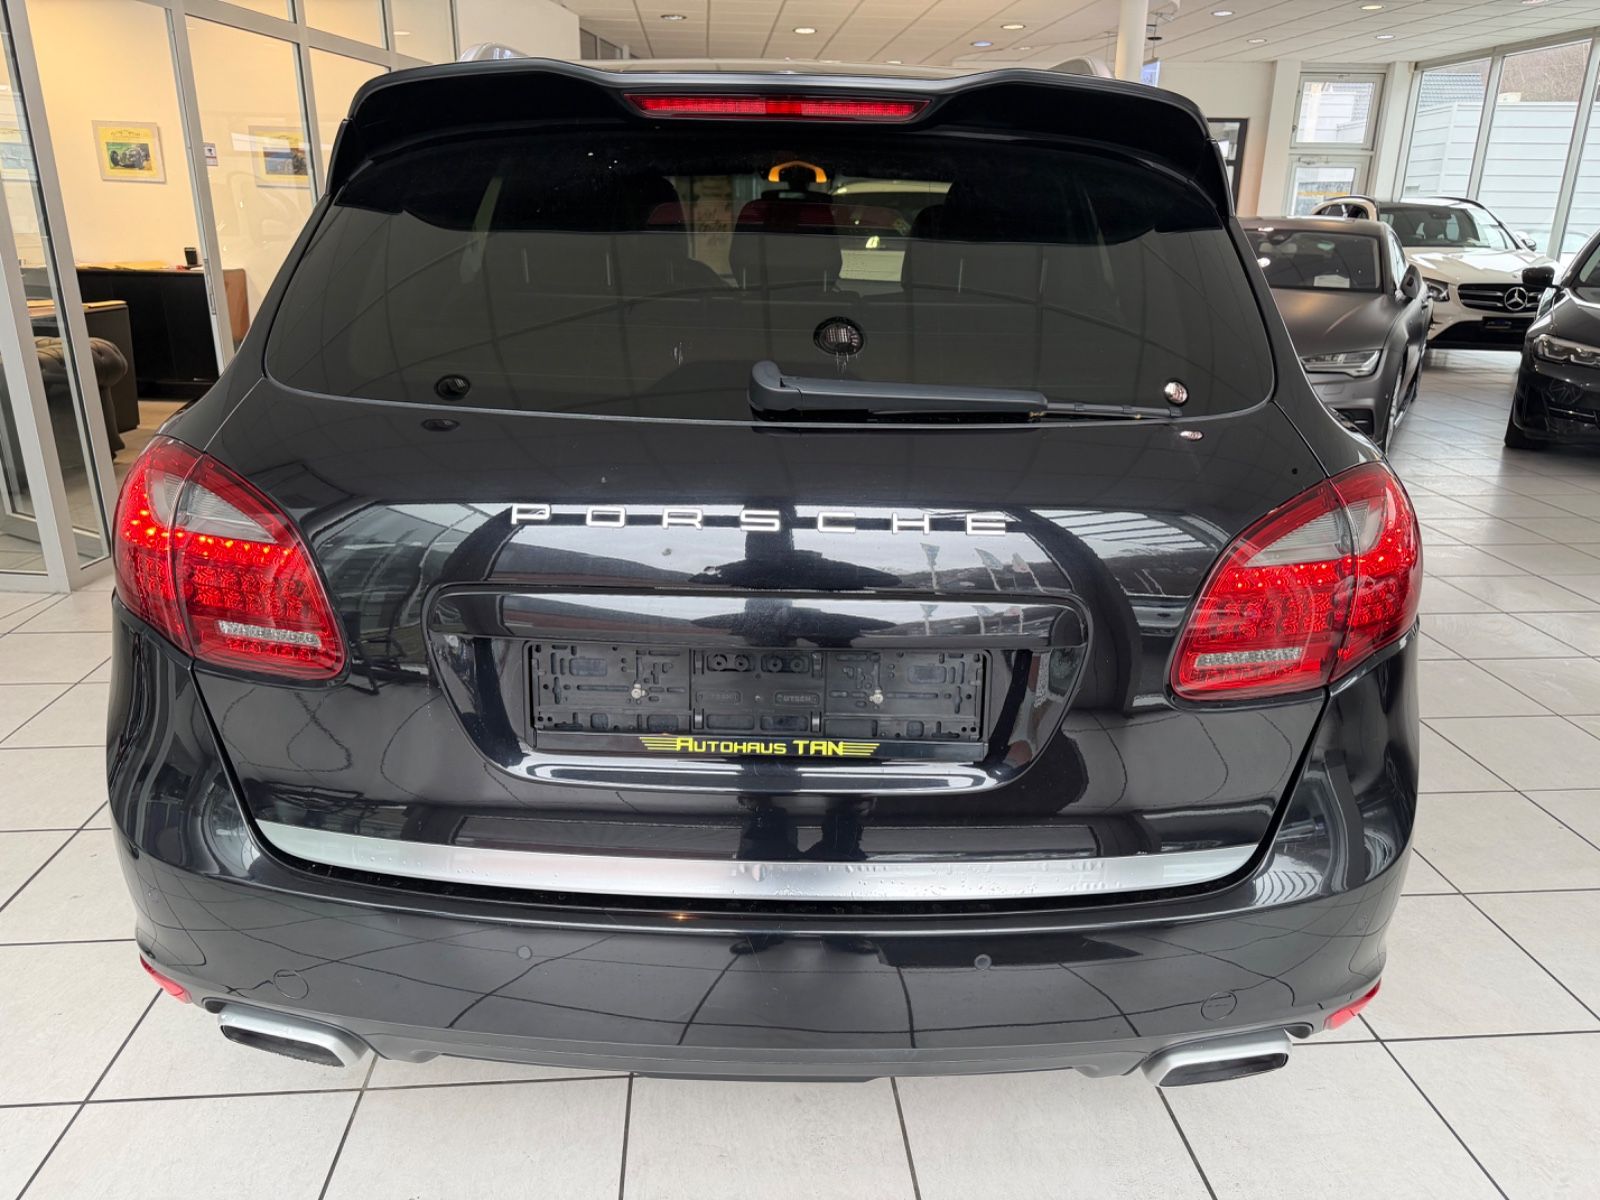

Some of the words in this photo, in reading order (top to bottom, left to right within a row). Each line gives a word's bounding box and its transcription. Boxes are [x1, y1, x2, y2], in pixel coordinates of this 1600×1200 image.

[510, 503, 1007, 536] PORSCHE
[676, 737, 787, 754] AUTOHAUS
[792, 739, 843, 756] TAN
